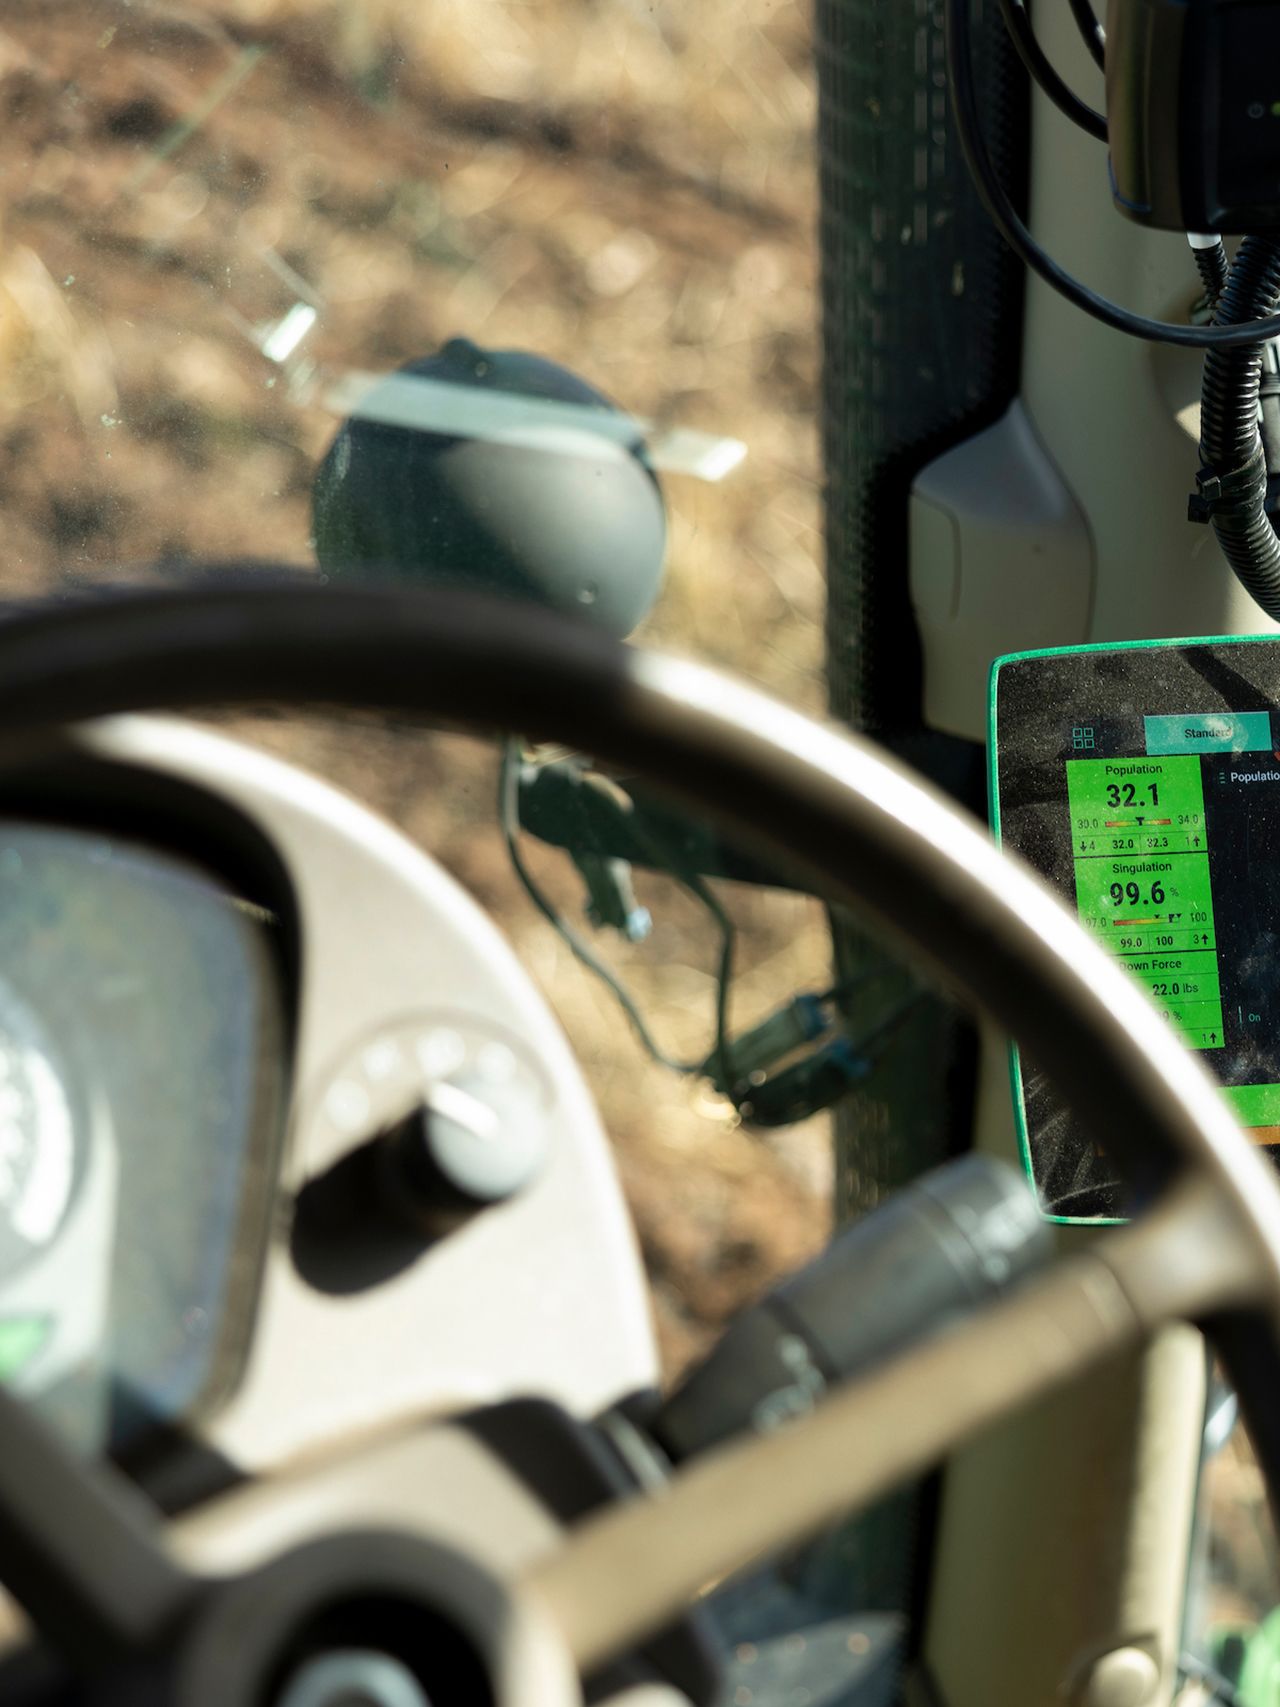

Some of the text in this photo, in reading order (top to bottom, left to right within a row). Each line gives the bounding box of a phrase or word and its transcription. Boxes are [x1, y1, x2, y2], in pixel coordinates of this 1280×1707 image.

[1185, 726, 1232, 739] Standard
[1105, 763, 1163, 777] Population
[1106, 783, 1159, 808] 32.1
[1178, 814, 1199, 825] 34.0
[1112, 839, 1134, 849] 32.0
[1147, 837, 1169, 848] 32.3
[1113, 862, 1173, 876] Singulation
[1110, 881, 1165, 906] 99.6
[1190, 912, 1207, 922] 100
[1120, 938, 1142, 948] 99.0
[1155, 936, 1173, 946] 100
[1152, 959, 1182, 970] Force
[1152, 982, 1199, 996] 22.0 lbs
[1248, 1013, 1261, 1022] On
